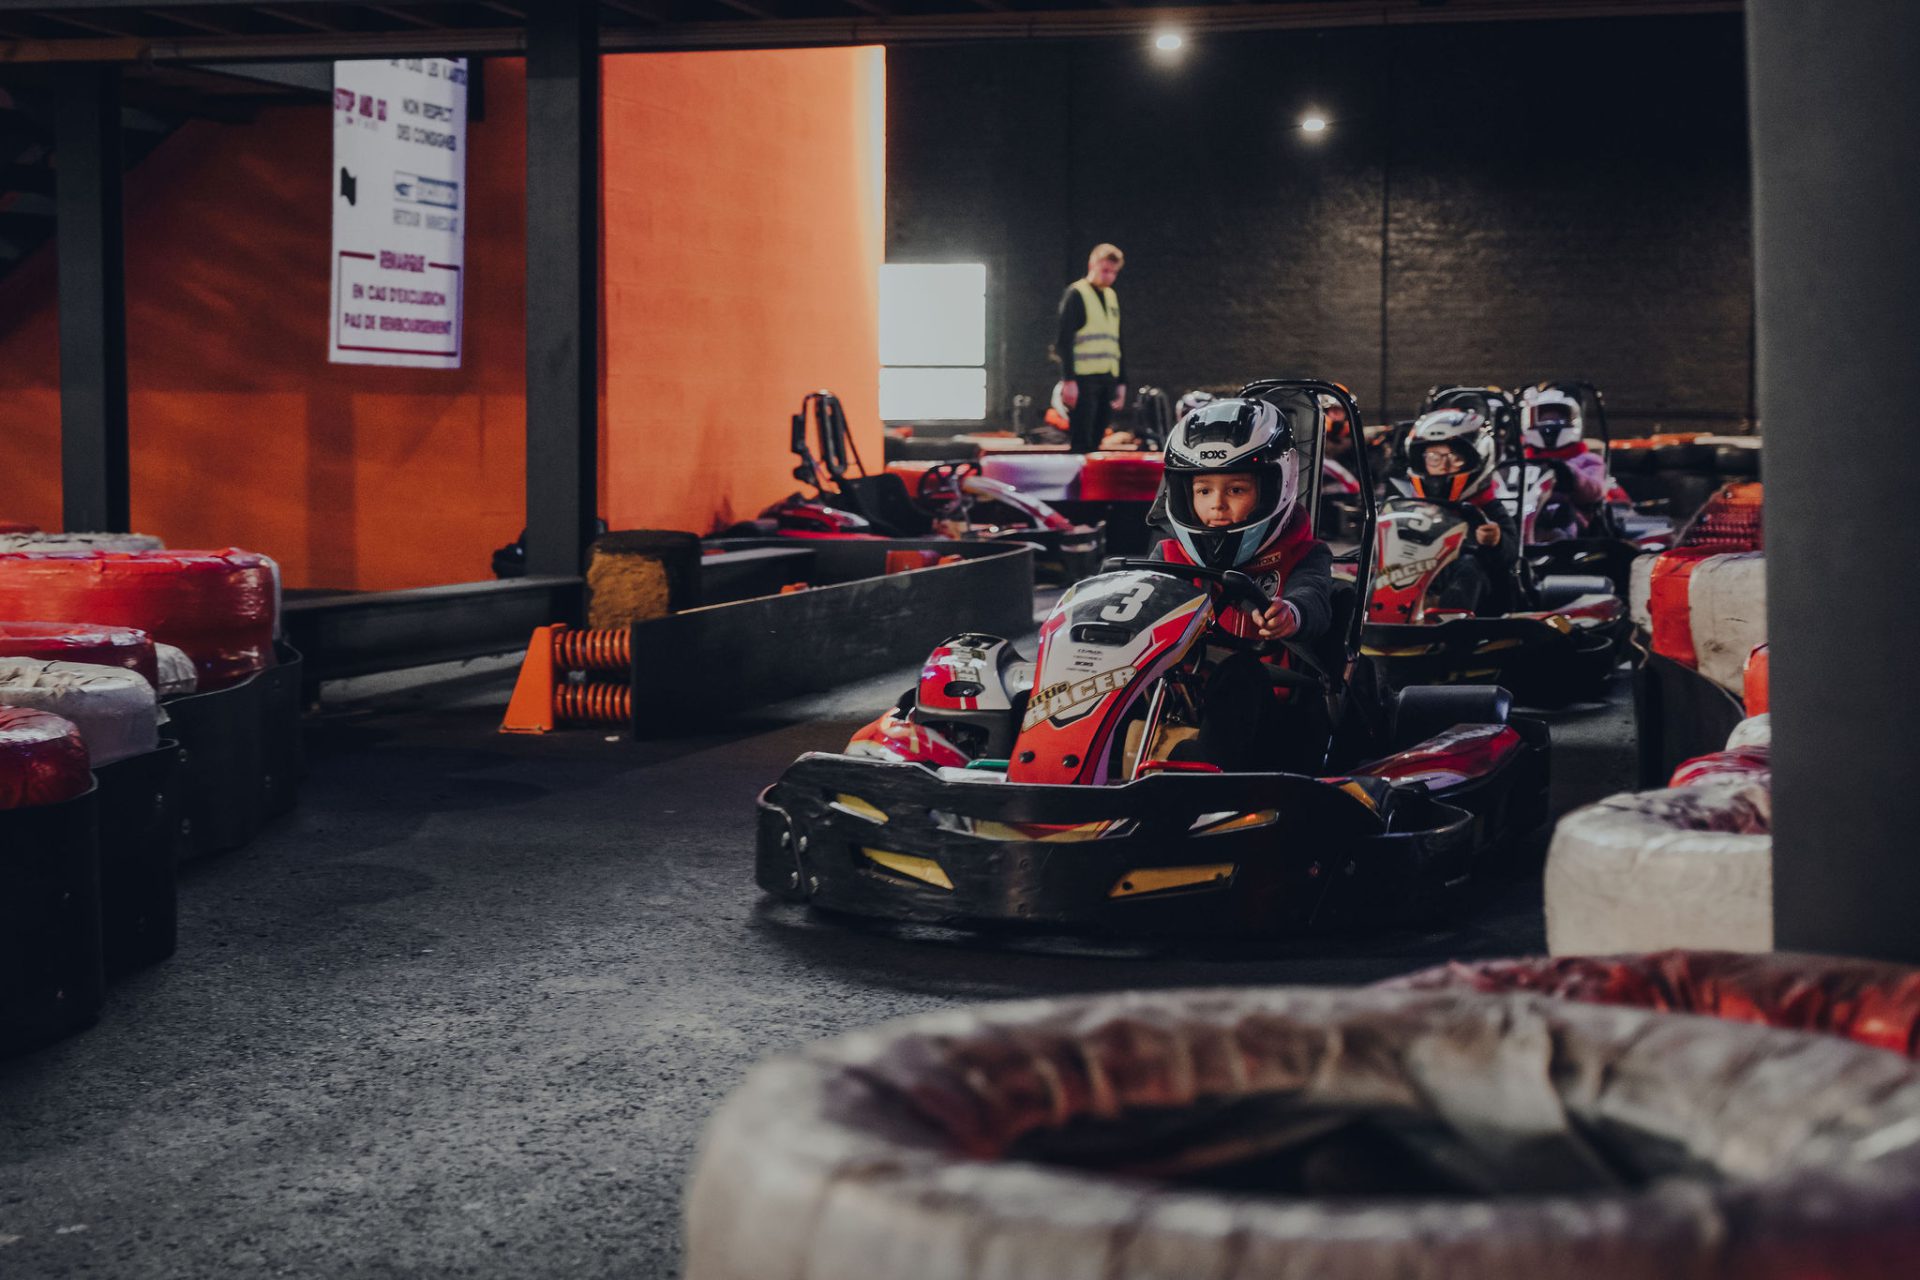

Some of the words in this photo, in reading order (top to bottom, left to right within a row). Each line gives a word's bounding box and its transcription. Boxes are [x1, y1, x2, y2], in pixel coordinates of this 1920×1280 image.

[368, 285, 386, 302] CAS
[344, 313, 361, 329] PAS
[364, 315, 376, 330] DE
[1199, 449, 1227, 460] BOXS
[1101, 582, 1155, 622] 3
[1023, 667, 1136, 725] RACER
